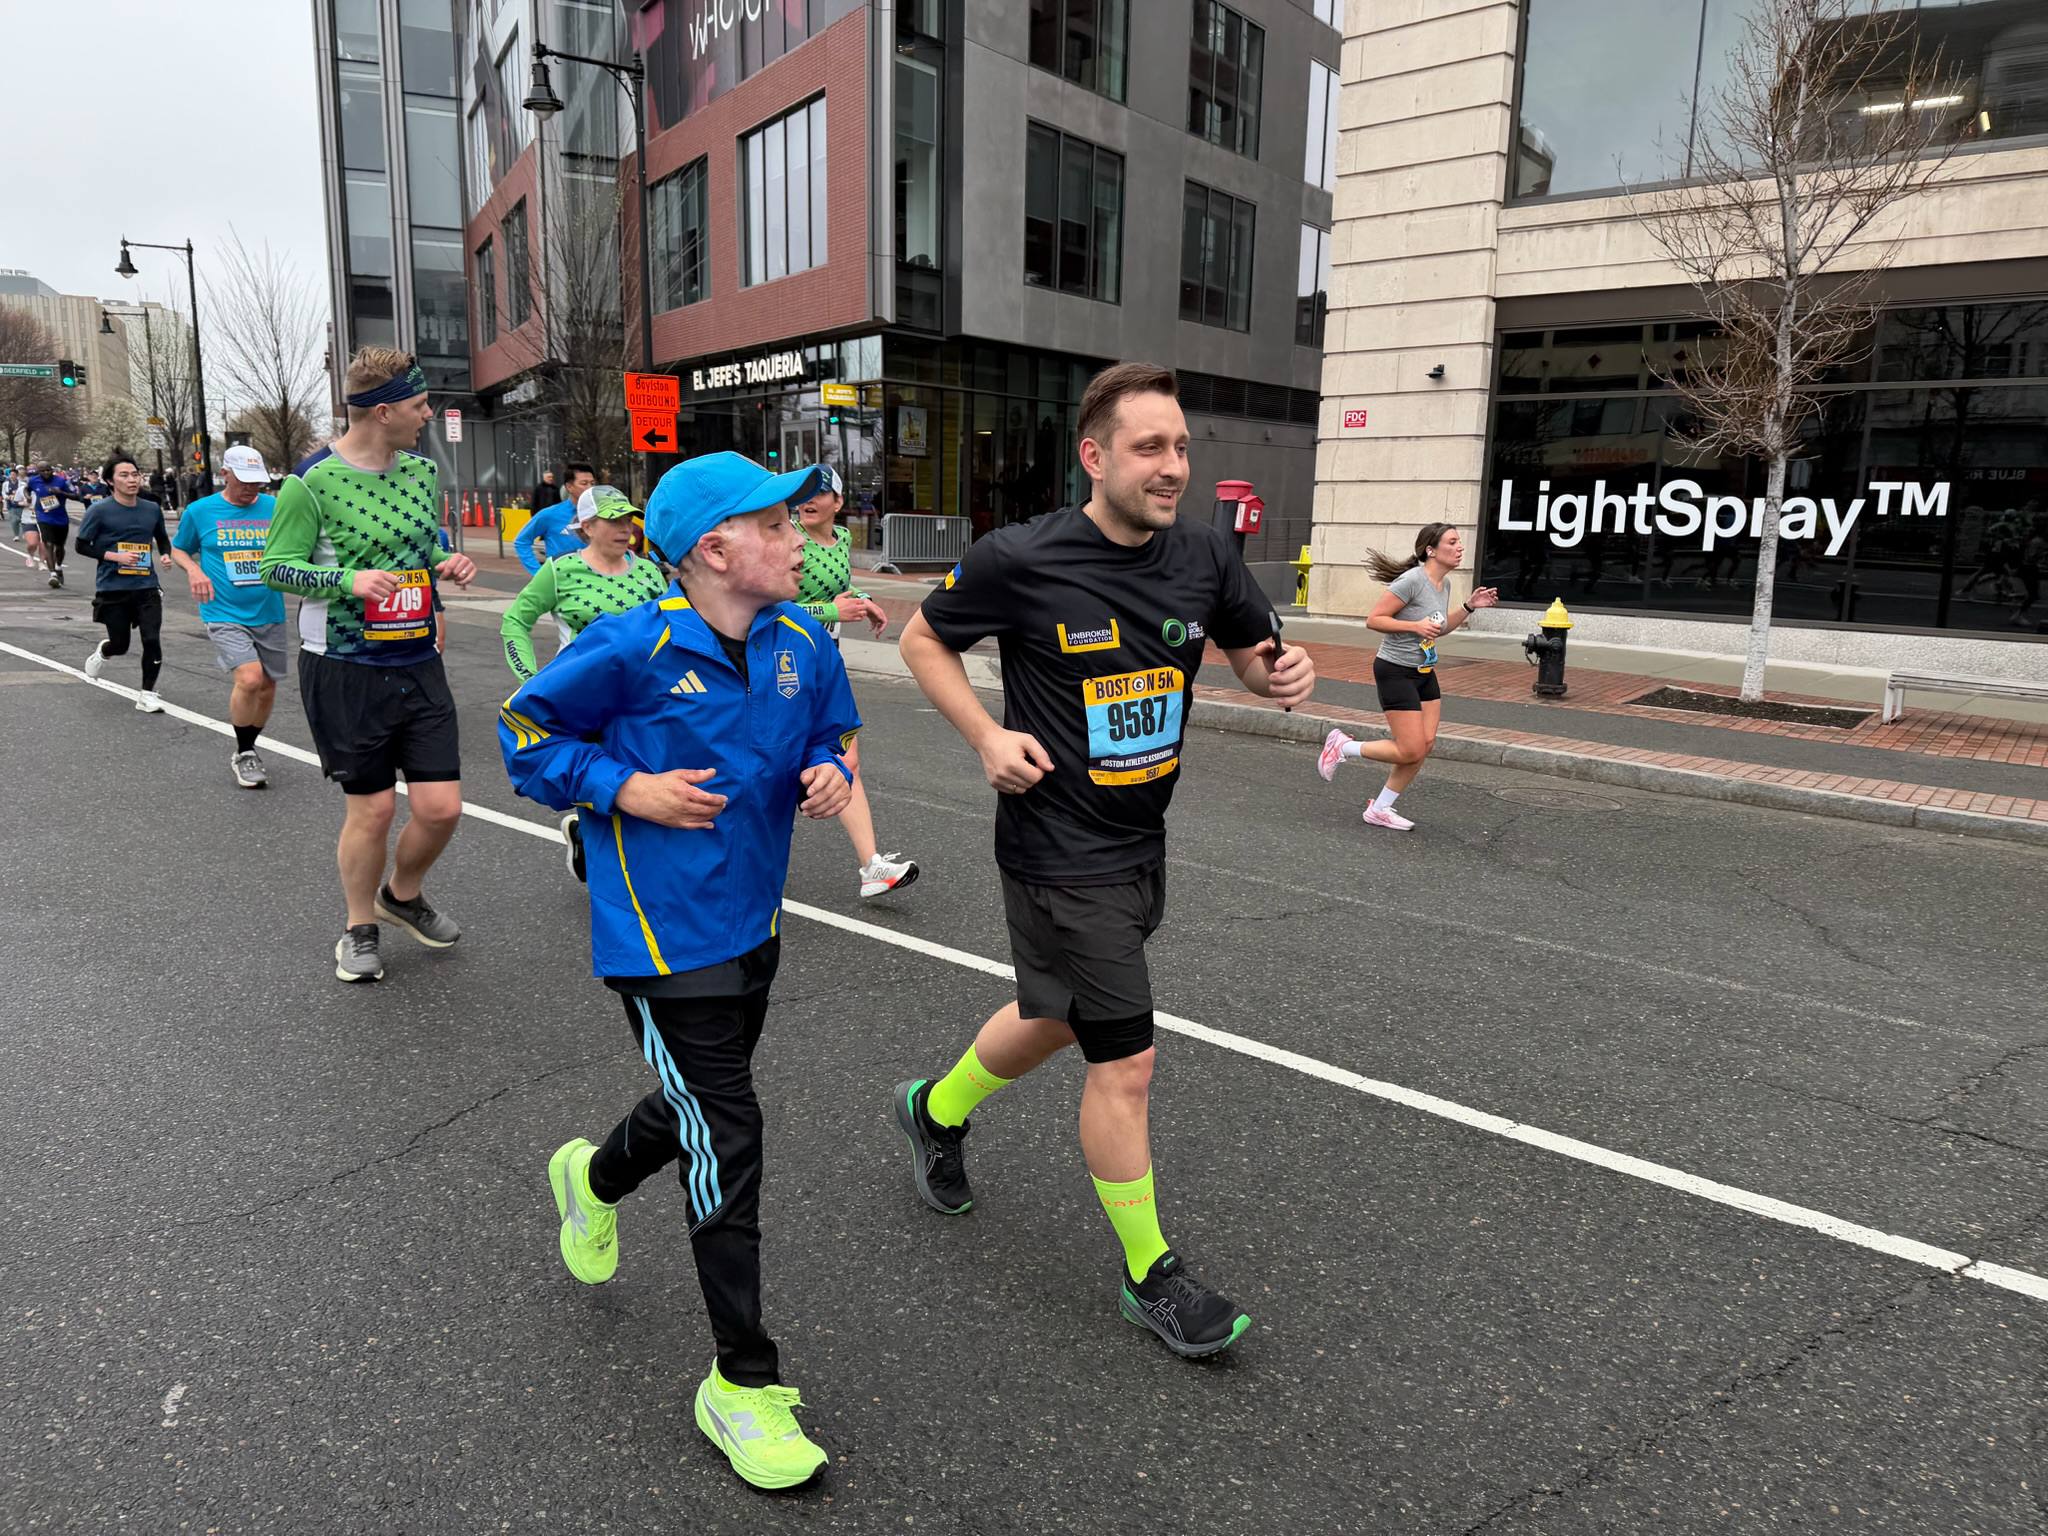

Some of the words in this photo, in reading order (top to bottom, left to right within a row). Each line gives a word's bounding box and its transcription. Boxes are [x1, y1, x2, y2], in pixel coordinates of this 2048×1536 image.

[693, 370, 706, 391] EL
[707, 363, 742, 389] JEFE'S
[744, 350, 804, 384] TAQUERIA
[635, 377, 669, 393] Boylston
[629, 393, 676, 408] OUTBOUND
[635, 416, 673, 428] DETOUR
[1346, 412, 1366, 421] FDC
[414, 572, 425, 584] 5K
[1067, 629, 1112, 640] UNBROKEN
[1069, 636, 1113, 645] FOUNDATION
[1096, 673, 1155, 700] BOSTON
[1157, 670, 1175, 689] 5K
[1107, 695, 1168, 742] 9587
[1100, 759, 1125, 768] BOSTON
[1125, 755, 1148, 767] ATHLETIC
